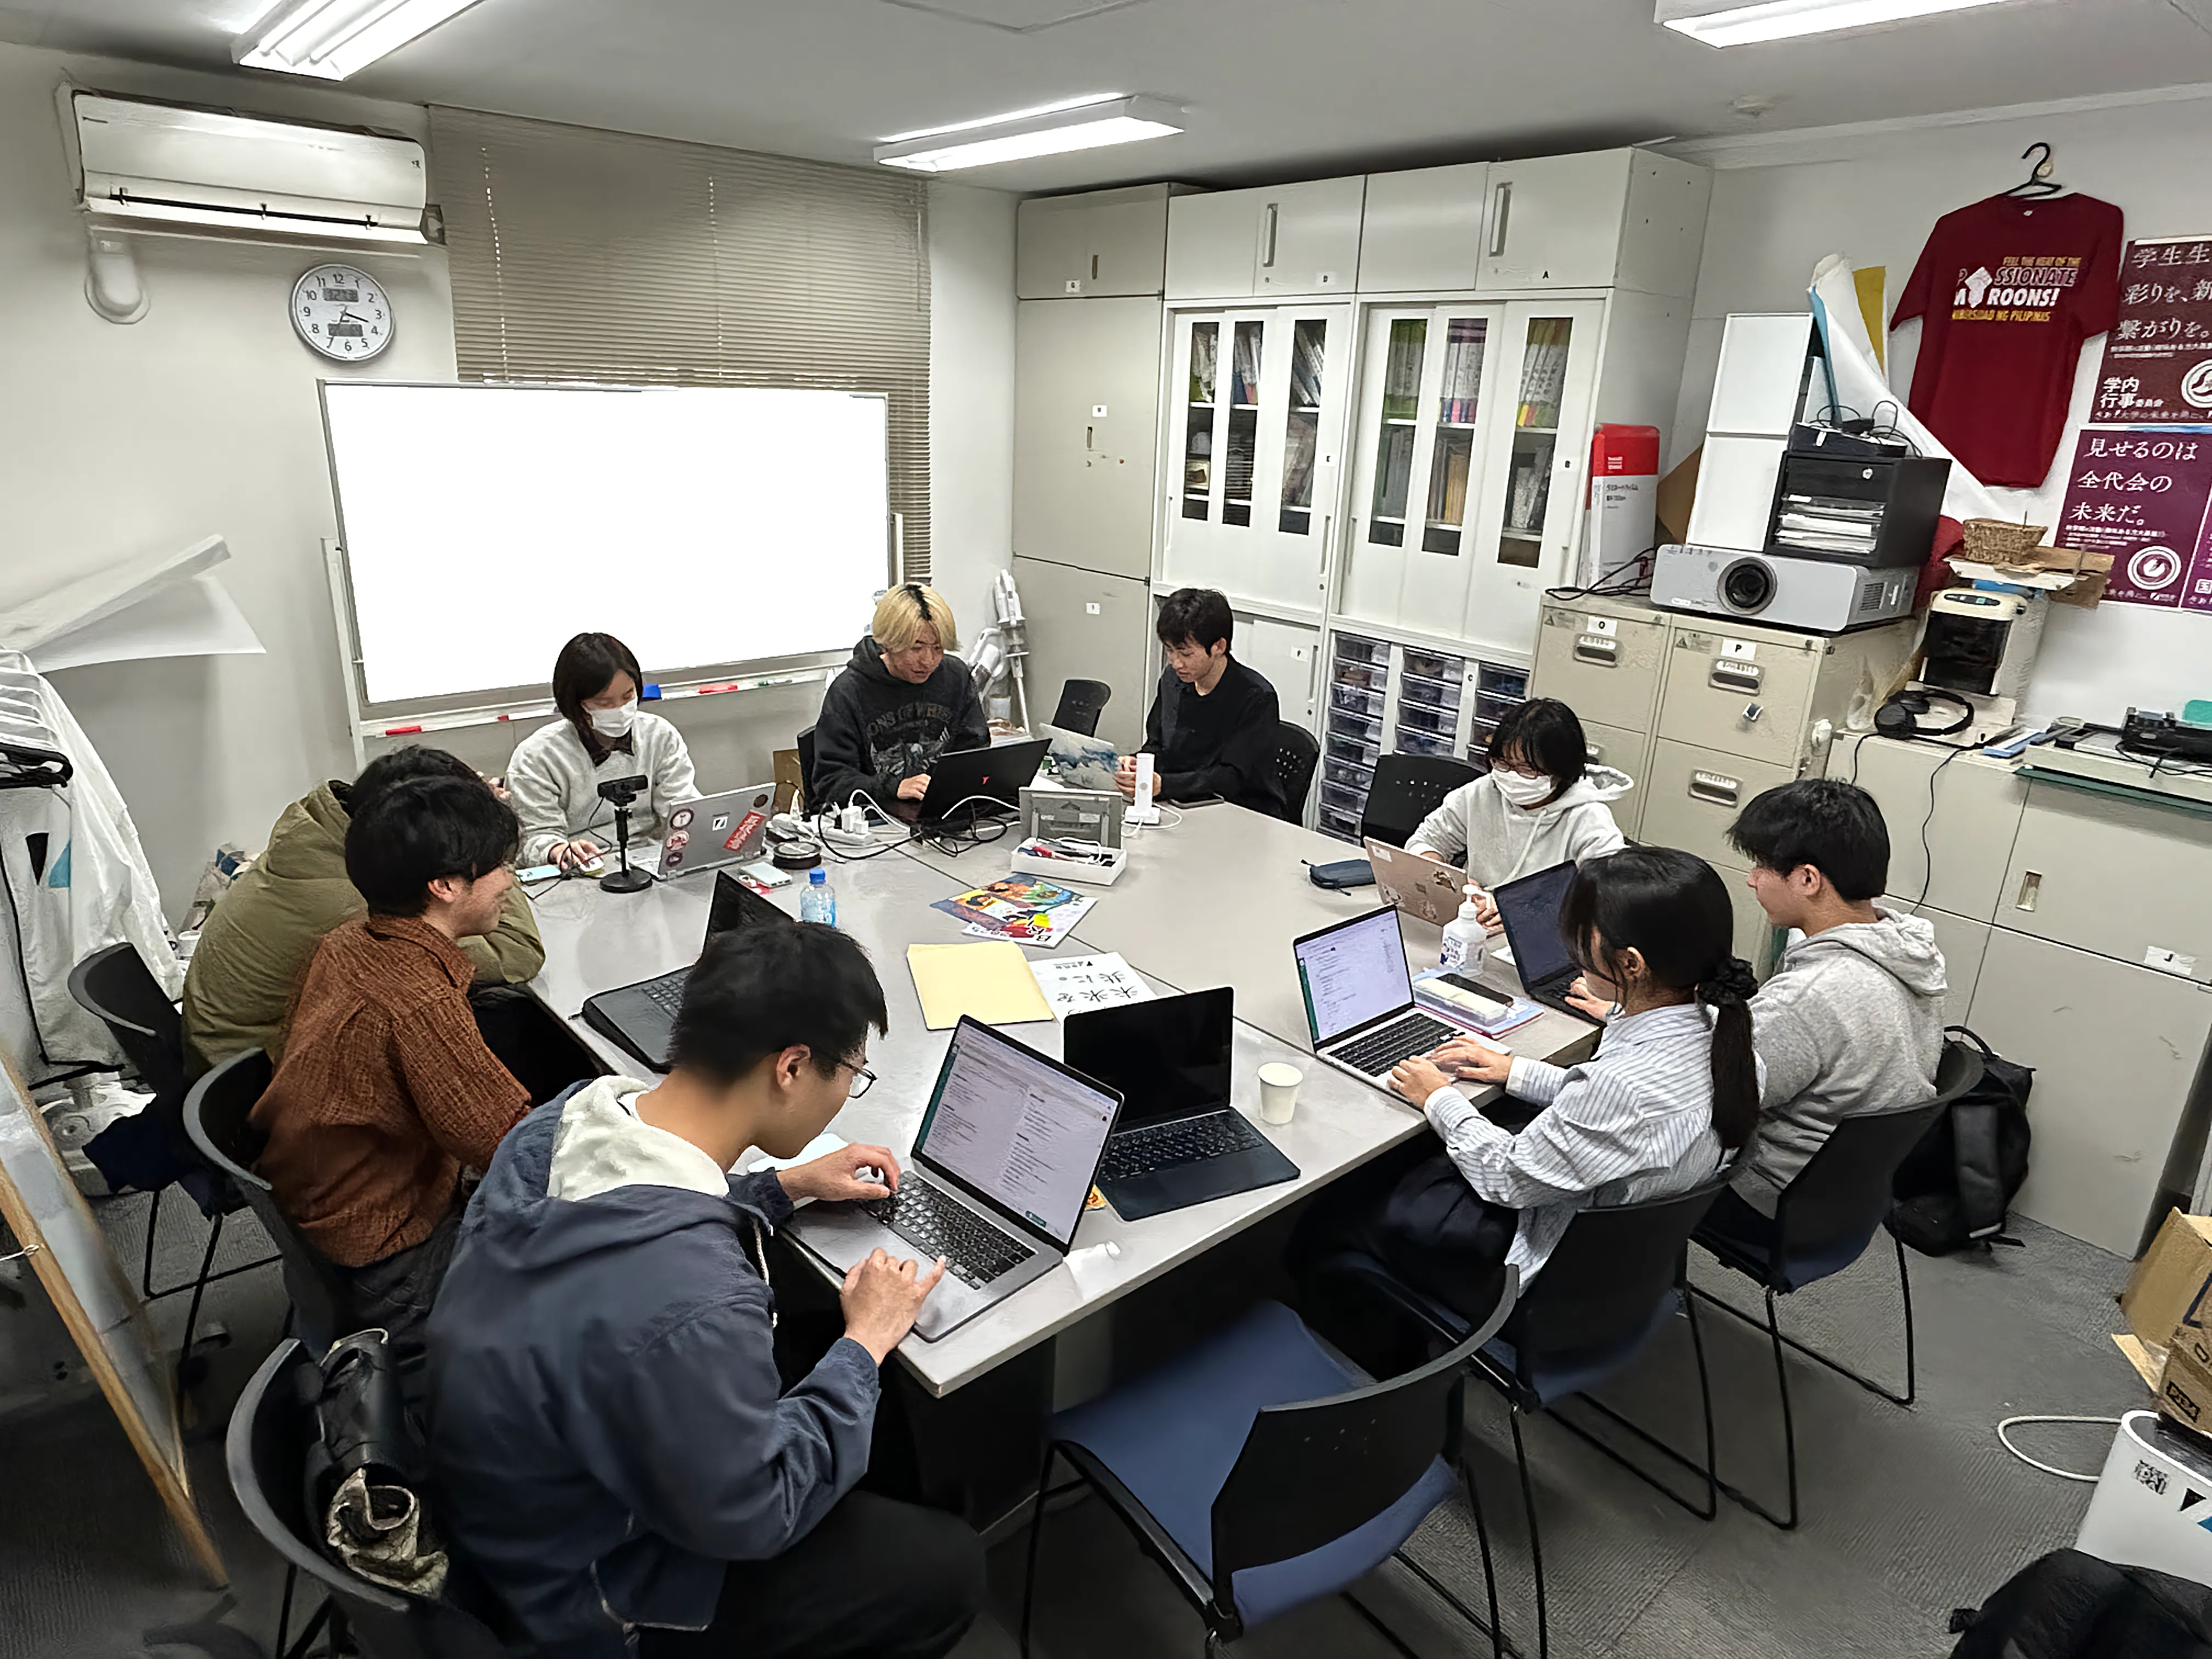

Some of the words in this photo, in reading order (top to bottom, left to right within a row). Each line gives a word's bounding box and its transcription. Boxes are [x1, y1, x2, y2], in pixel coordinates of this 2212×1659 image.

[333, 274, 345, 284] 12
[1542, 270, 1549, 279] A
[315, 275, 325, 287] 11
[303, 290, 317, 300] 10
[368, 293, 375, 303] 2
[303, 307, 311, 317] 9
[375, 309, 382, 319] 3
[312, 324, 319, 334] 8
[371, 326, 378, 335] 4
[326, 336, 334, 348] 7
[345, 341, 352, 351] 6
[361, 338, 369, 348] 5
[2103, 377, 2140, 392] 学内
[2083, 438, 2199, 460] 見せるのは
[2077, 470, 2172, 493] 全代会の
[2068, 502, 2145, 526] 未来だ。
[1735, 644, 1742, 652] P
[2164, 953, 2174, 962] J
